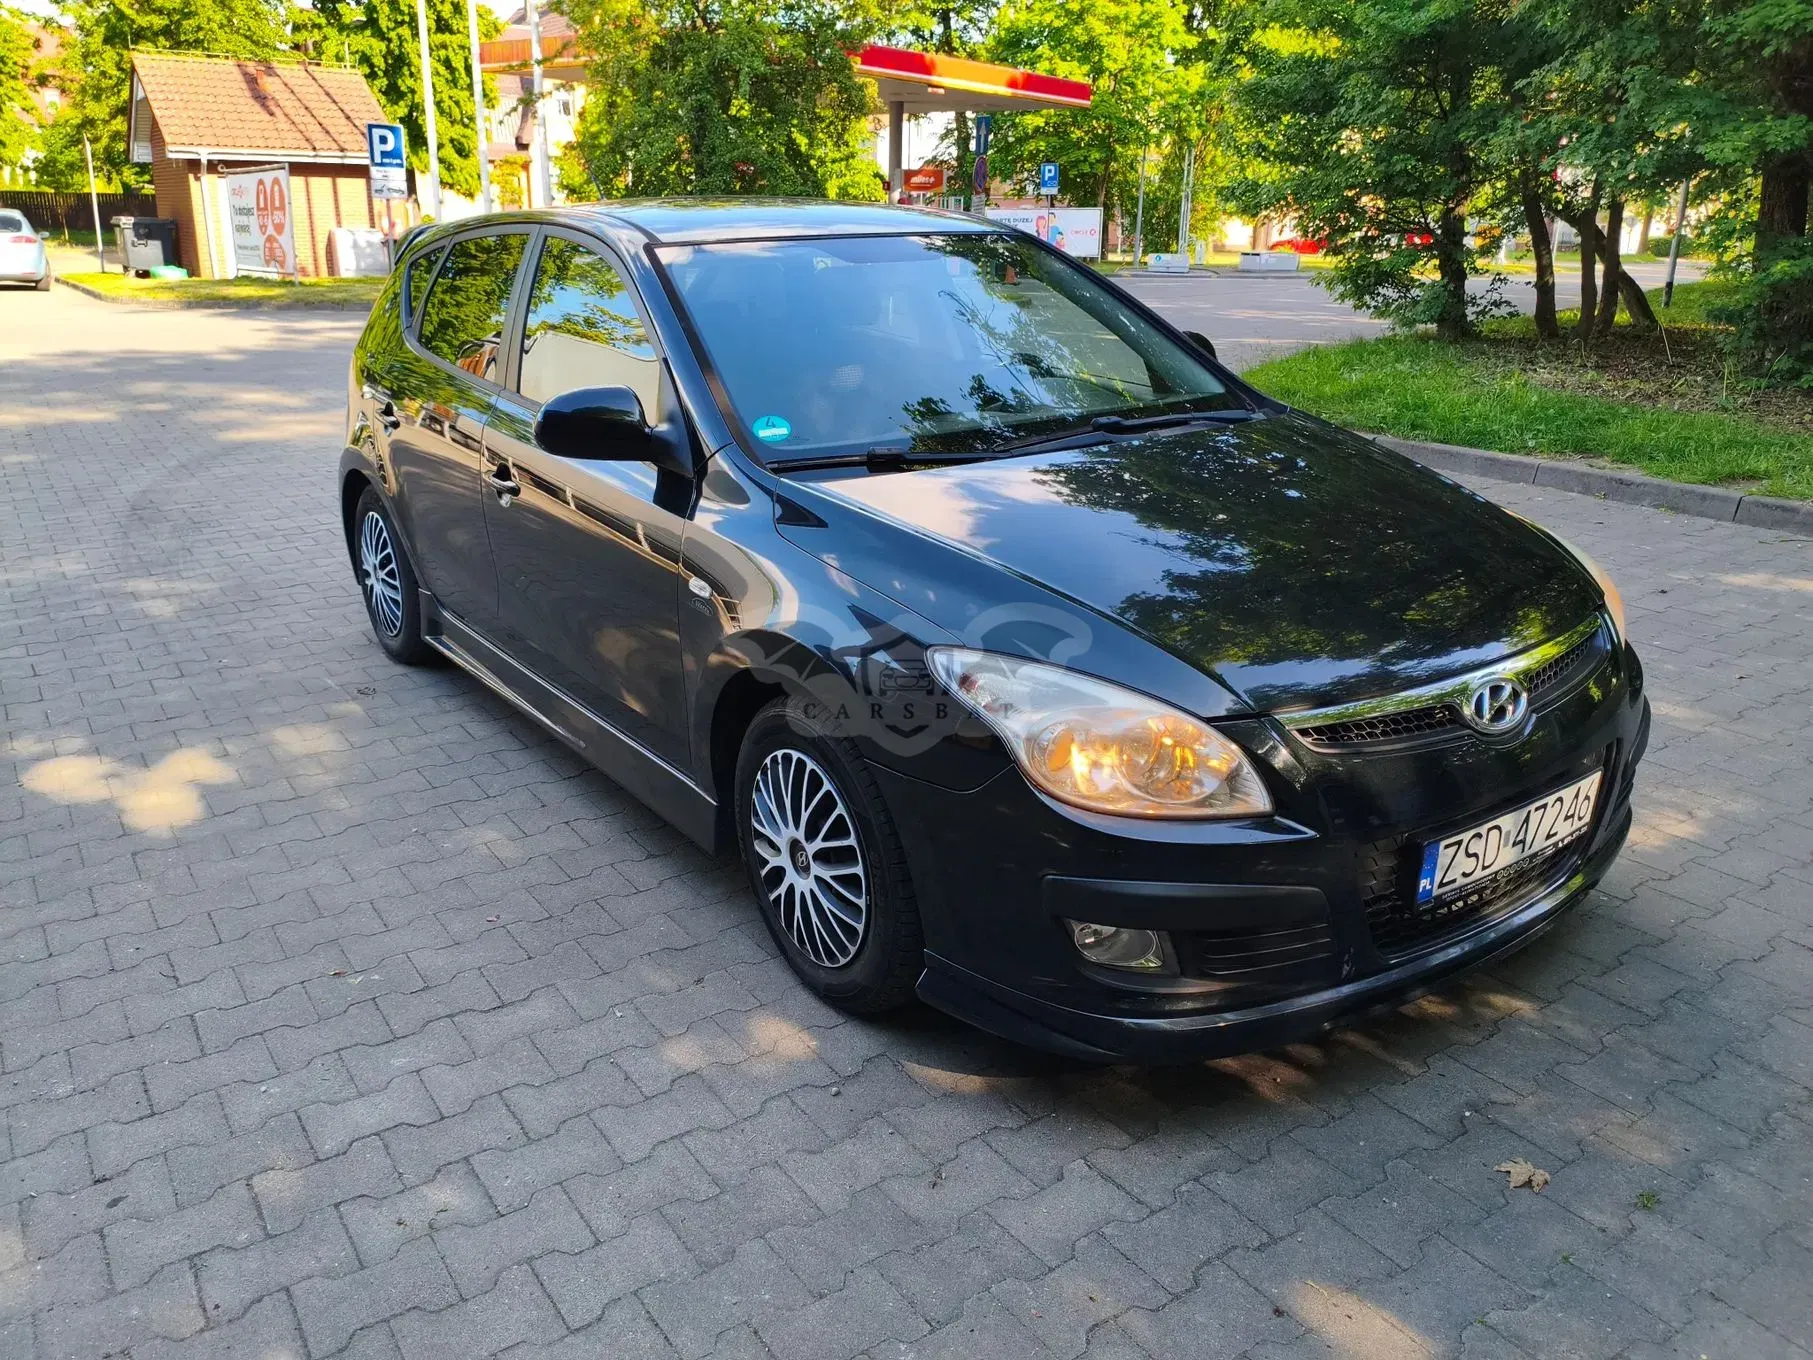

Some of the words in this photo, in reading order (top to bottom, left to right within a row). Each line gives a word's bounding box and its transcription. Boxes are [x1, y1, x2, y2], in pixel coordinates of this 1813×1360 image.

[371, 128, 395, 163] P
[1045, 165, 1055, 181] P
[1437, 824, 1503, 890] ZSD
[1511, 779, 1595, 854] 47246
[1419, 878, 1432, 893] PL
